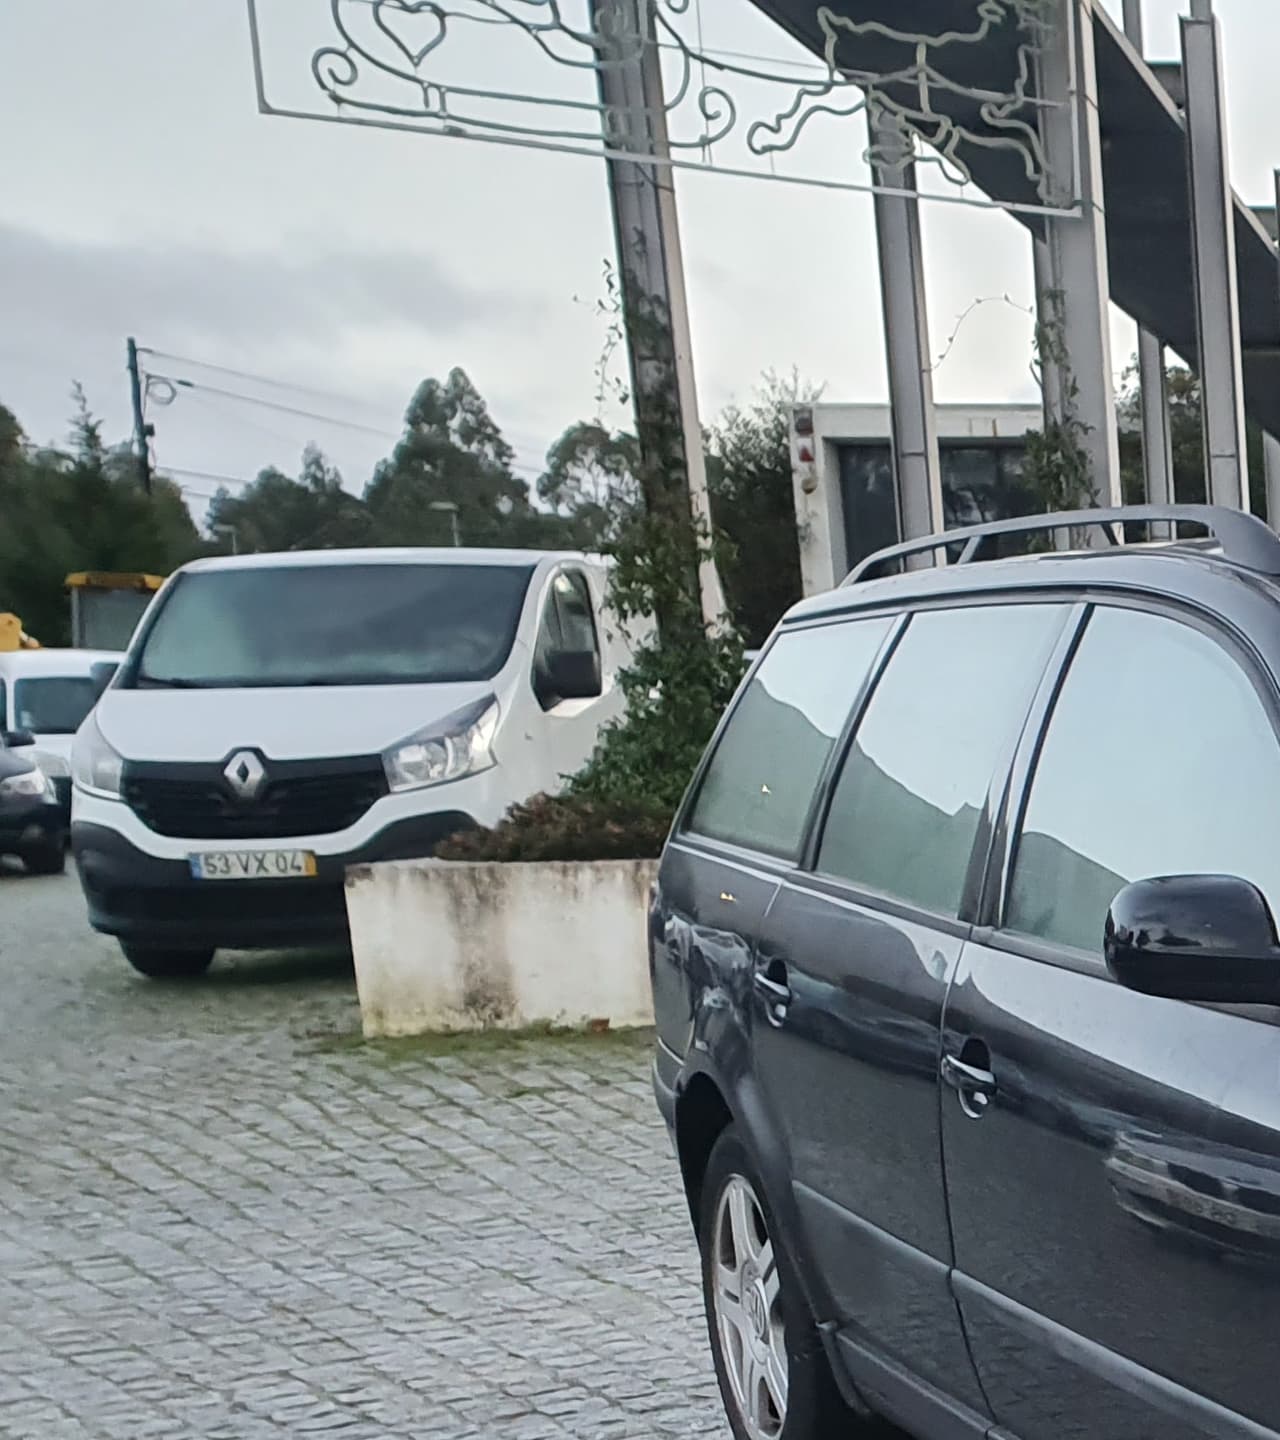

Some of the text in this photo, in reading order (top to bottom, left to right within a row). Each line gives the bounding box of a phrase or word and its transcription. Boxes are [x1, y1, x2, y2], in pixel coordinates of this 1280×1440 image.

[204, 850, 302, 874] 53 VX 04
